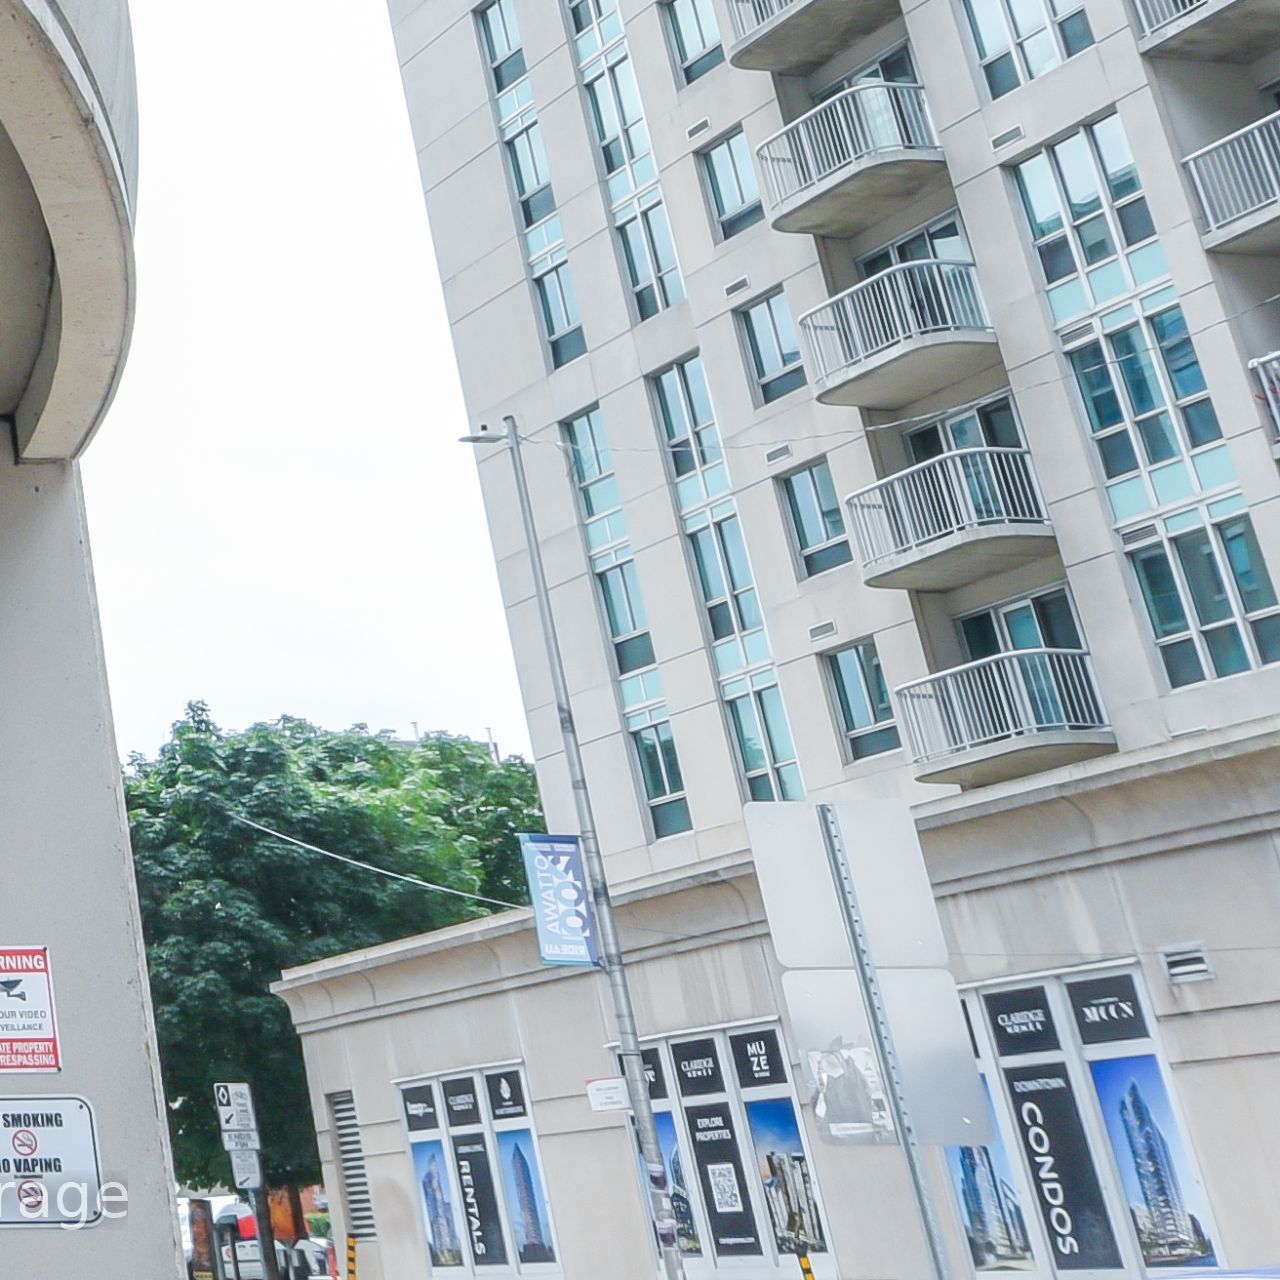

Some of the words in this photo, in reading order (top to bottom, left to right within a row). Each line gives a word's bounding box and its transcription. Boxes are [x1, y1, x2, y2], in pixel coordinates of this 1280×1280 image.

[19, 1010, 47, 1019] VIDEO
[13, 1041, 54, 1054] PROPERTY
[746, 1040, 766, 1056] MU
[750, 1055, 770, 1071] ZE
[2, 1113, 63, 1128] SMOKING
[13, 1157, 62, 1173] VAPING
[1021, 1100, 1080, 1255] CONDOS
[458, 1160, 487, 1256] RENTALS
